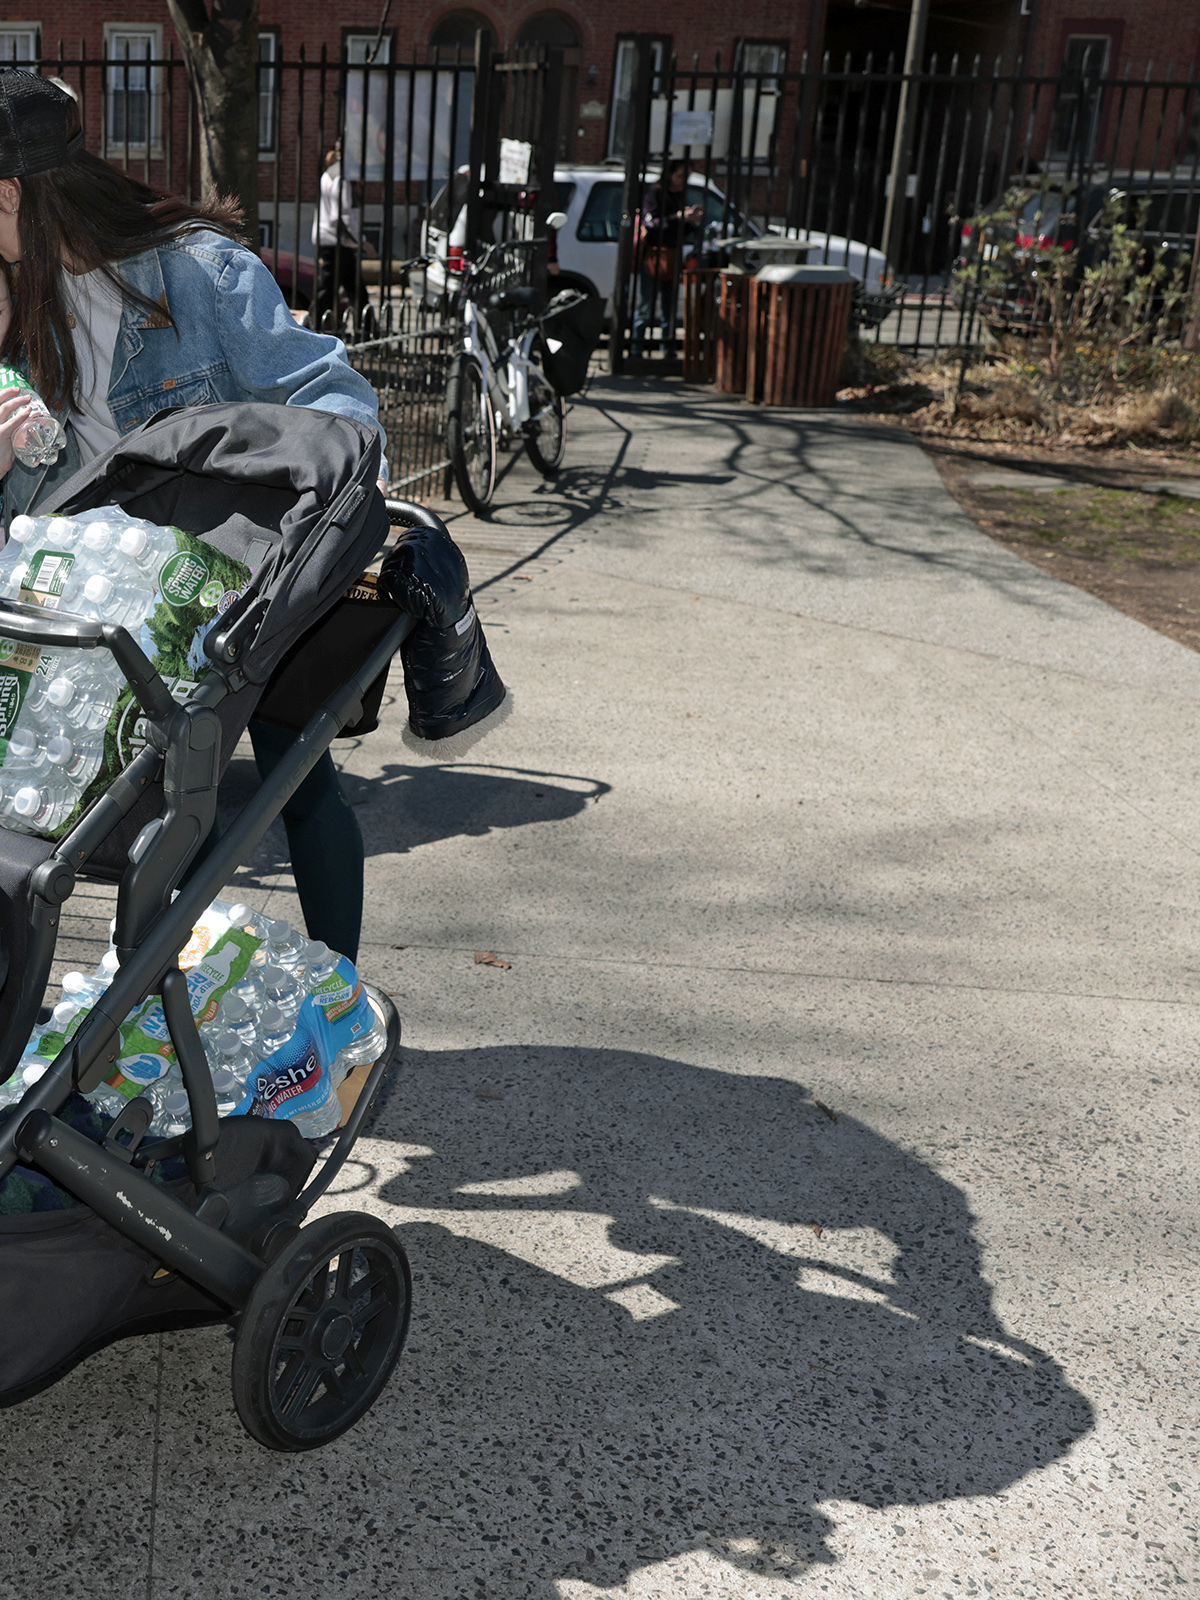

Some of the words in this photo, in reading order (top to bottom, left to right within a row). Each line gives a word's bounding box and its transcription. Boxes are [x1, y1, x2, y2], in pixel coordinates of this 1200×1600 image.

[168, 557, 197, 597] SPRING
[178, 565, 207, 601] WATER
[35, 655, 52, 677] 24
[200, 962, 225, 982] RECYCLE
[199, 980, 216, 994] HELP
[315, 979, 344, 994] RECYCLE
[191, 995, 203, 1013] YOU
[275, 1085, 304, 1105] WATER
